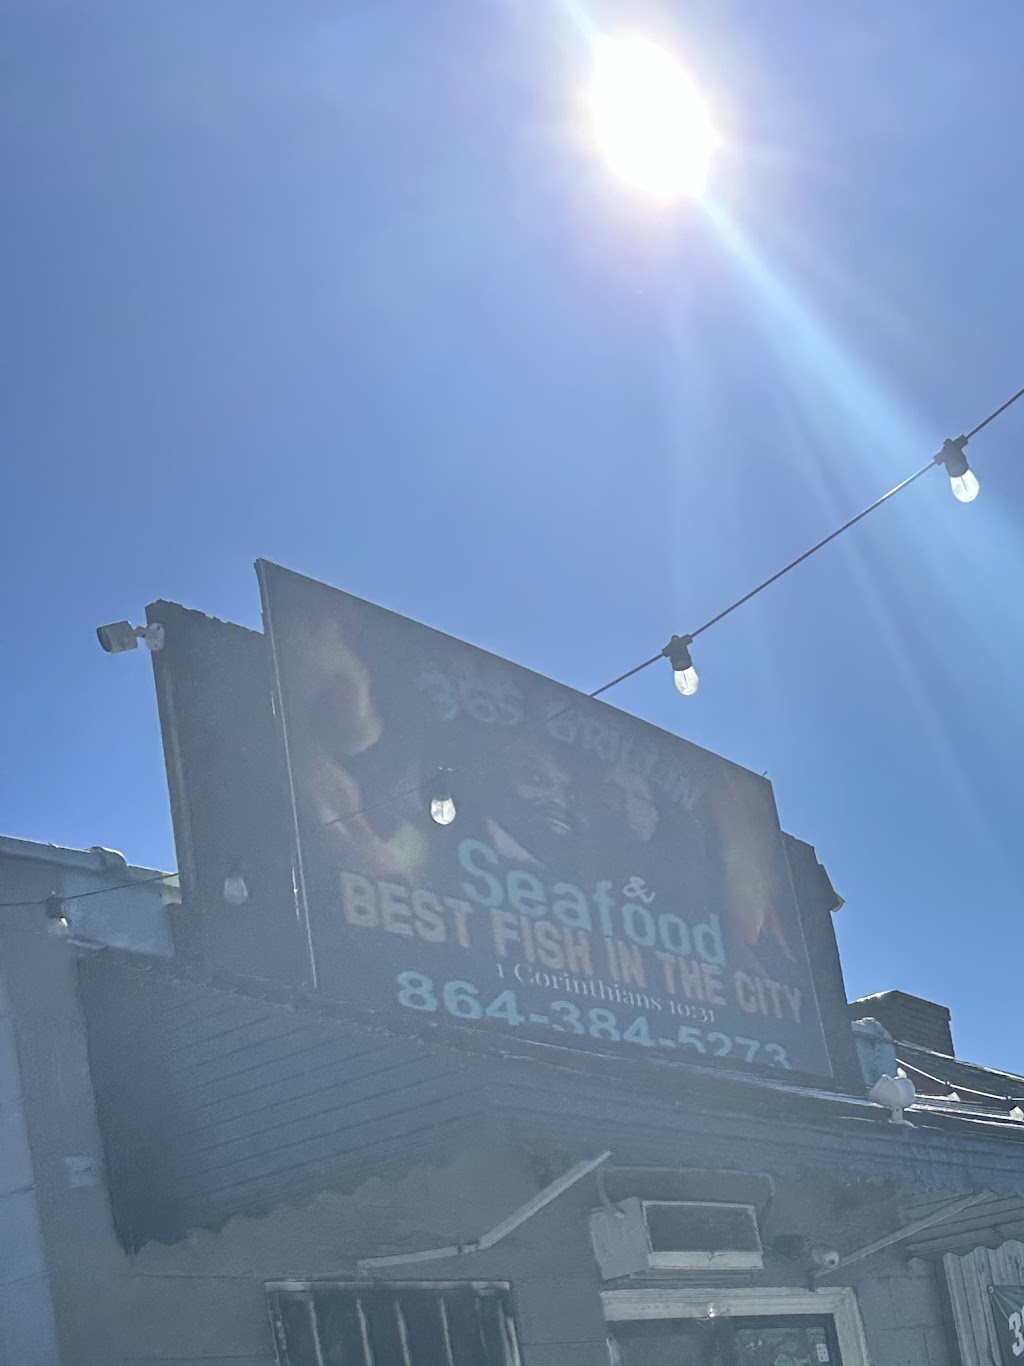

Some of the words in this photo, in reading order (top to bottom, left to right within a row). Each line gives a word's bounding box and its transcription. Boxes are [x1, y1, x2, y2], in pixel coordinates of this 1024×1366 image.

[456, 837, 725, 967] Seafood
[621, 876, 657, 903] &
[340, 870, 473, 949] BEST
[490, 906, 593, 978] FISH
[605, 940, 646, 988] IN
[655, 951, 728, 1008] THE
[733, 971, 802, 1024] CITY
[513, 963, 663, 1011] Corinthians
